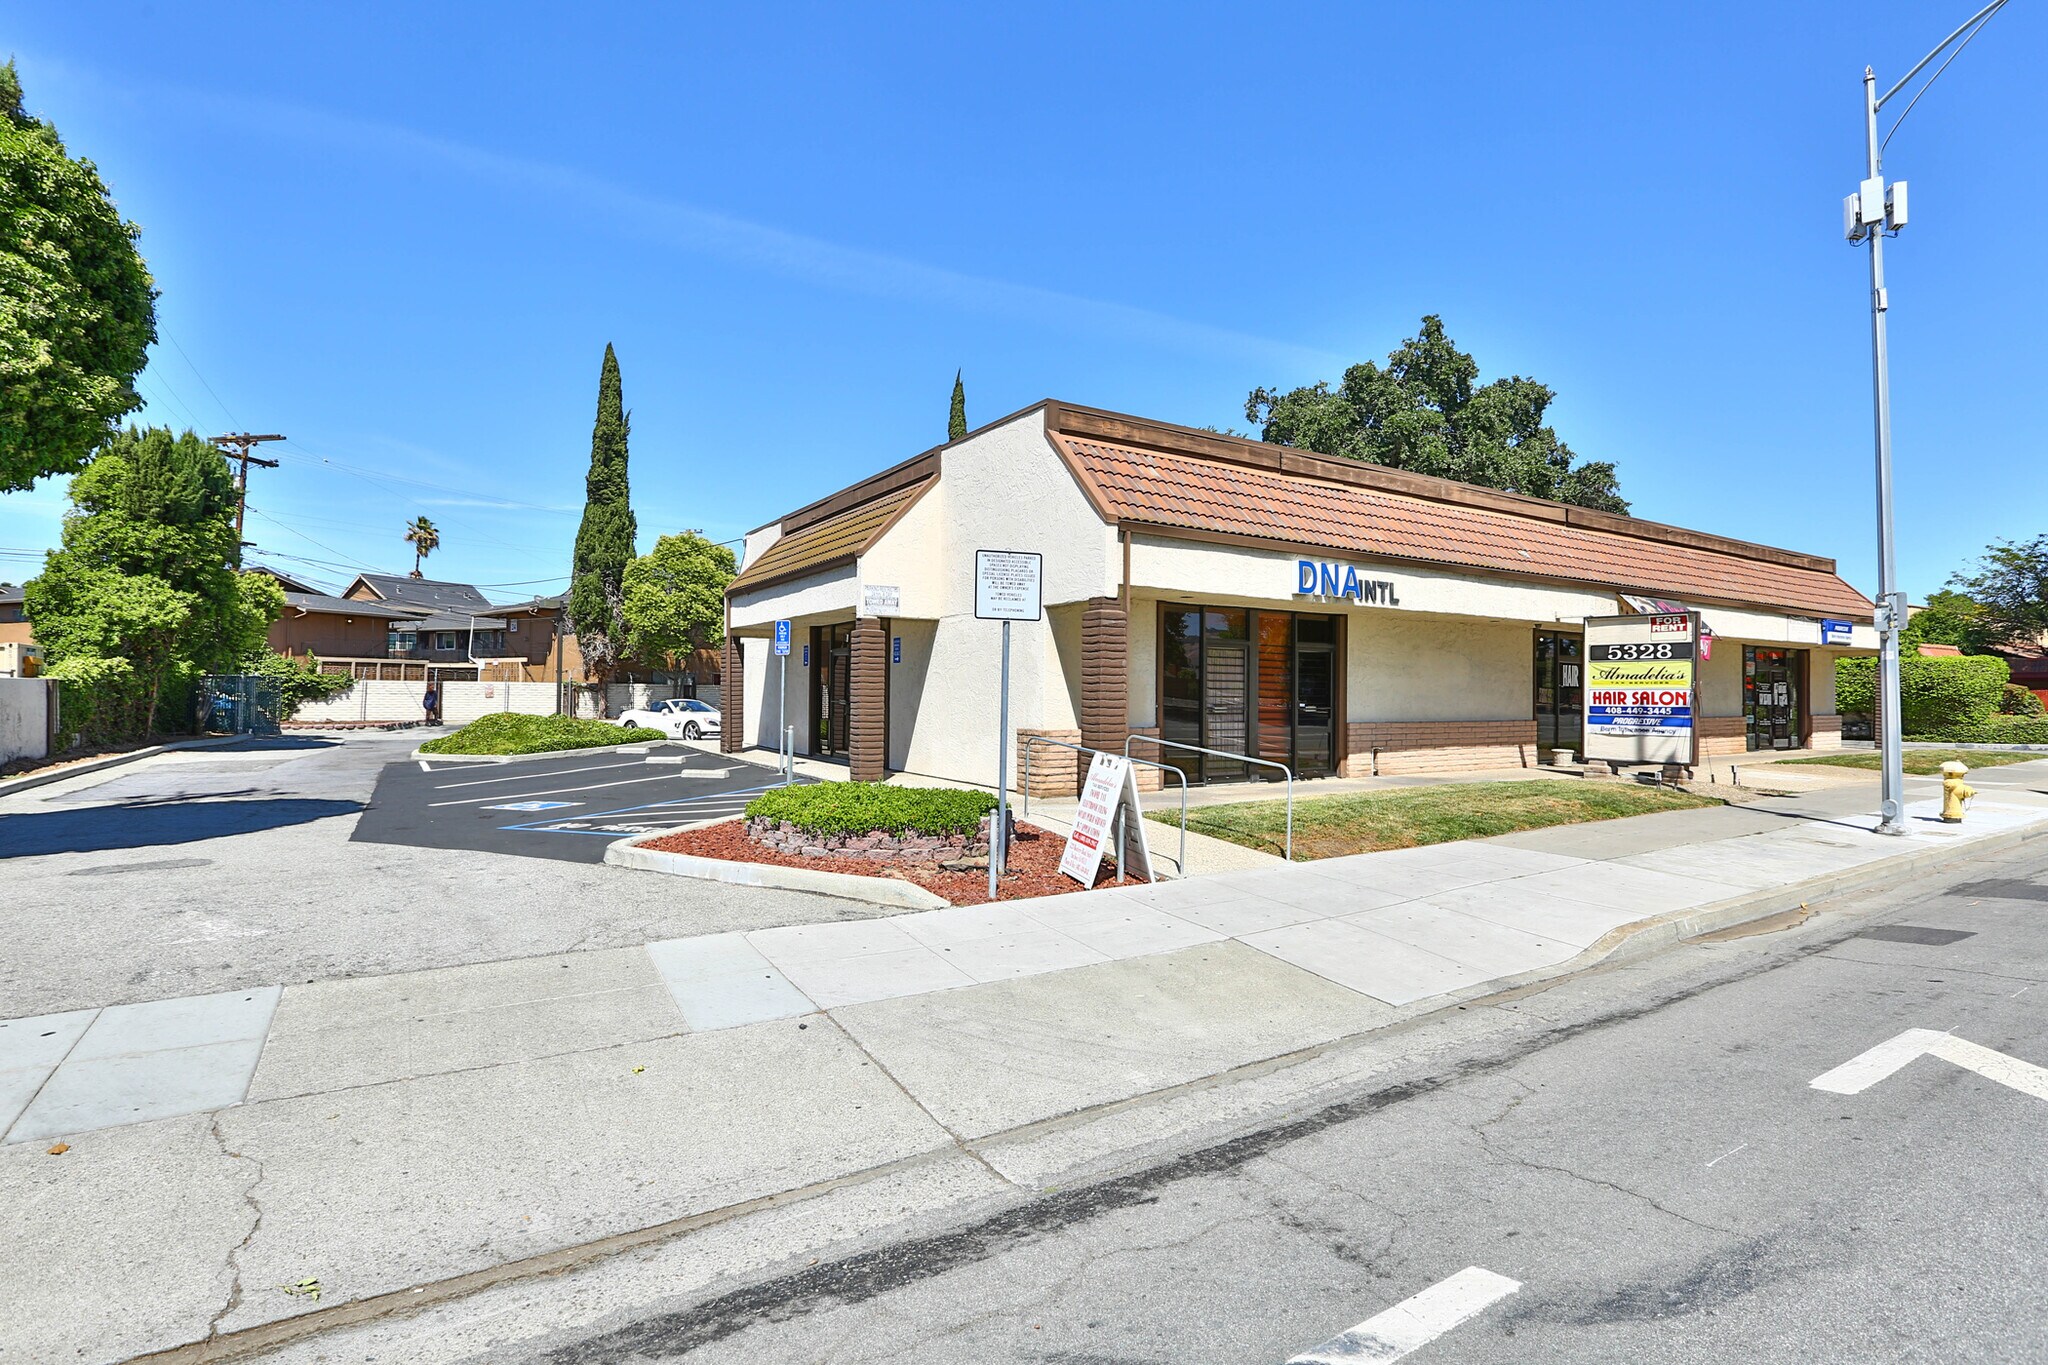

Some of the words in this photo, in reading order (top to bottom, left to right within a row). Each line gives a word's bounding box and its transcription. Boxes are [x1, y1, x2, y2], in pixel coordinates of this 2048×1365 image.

[1298, 560, 1361, 599] DNA
[1358, 579, 1400, 606] INTL
[1652, 624, 1686, 633] RENT
[1608, 644, 1672, 660] 5328
[1562, 665, 1579, 687] HAIR
[1592, 666, 1686, 681] Almadelia's
[1592, 691, 1628, 705] HAIR
[1633, 691, 1687, 706] SALON
[1605, 707, 1672, 715] 408-449-3445
[1612, 717, 1662, 726] PROGRESSIVE
